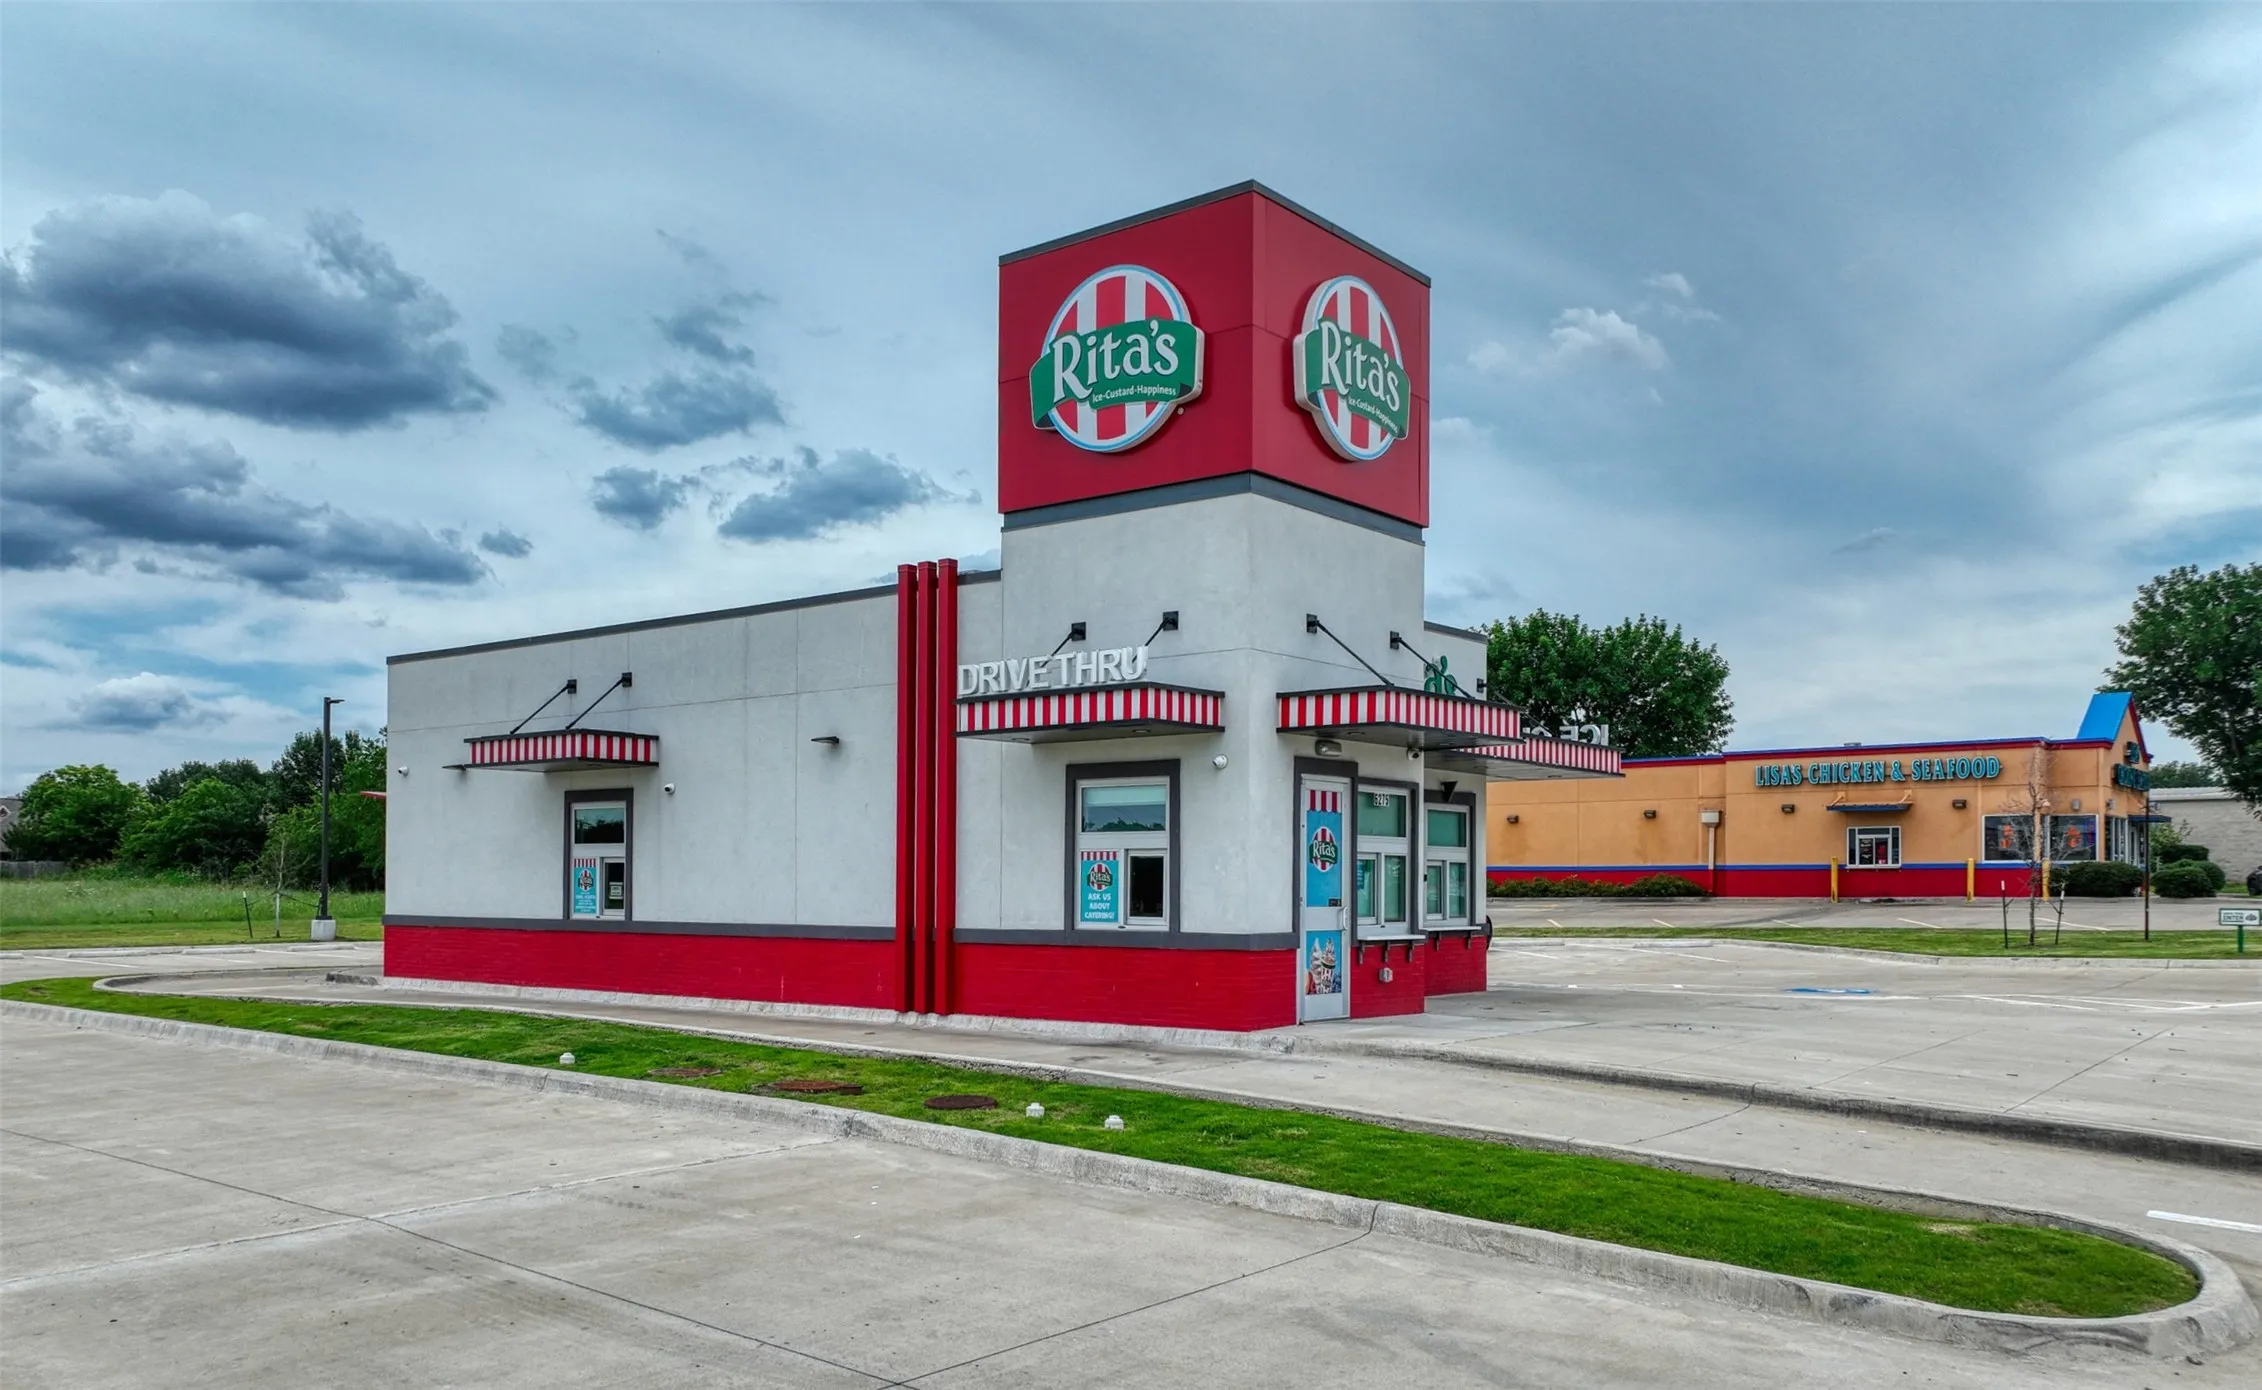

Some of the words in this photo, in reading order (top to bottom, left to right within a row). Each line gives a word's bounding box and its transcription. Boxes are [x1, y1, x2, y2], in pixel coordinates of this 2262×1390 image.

[1053, 319, 1179, 403] Rita's
[1320, 320, 1400, 412] Rita's
[958, 655, 1051, 696] DRIVE
[1053, 645, 1149, 686] THRU
[1808, 761, 1885, 784] CHICKEN
[1890, 760, 1906, 781] &
[1911, 756, 2000, 780] SEAFOOD
[1313, 839, 1336, 858] Rita's
[1088, 893, 1101, 901] ASK
[1103, 893, 1112, 901] US
[1089, 902, 1110, 910] ABOUT
